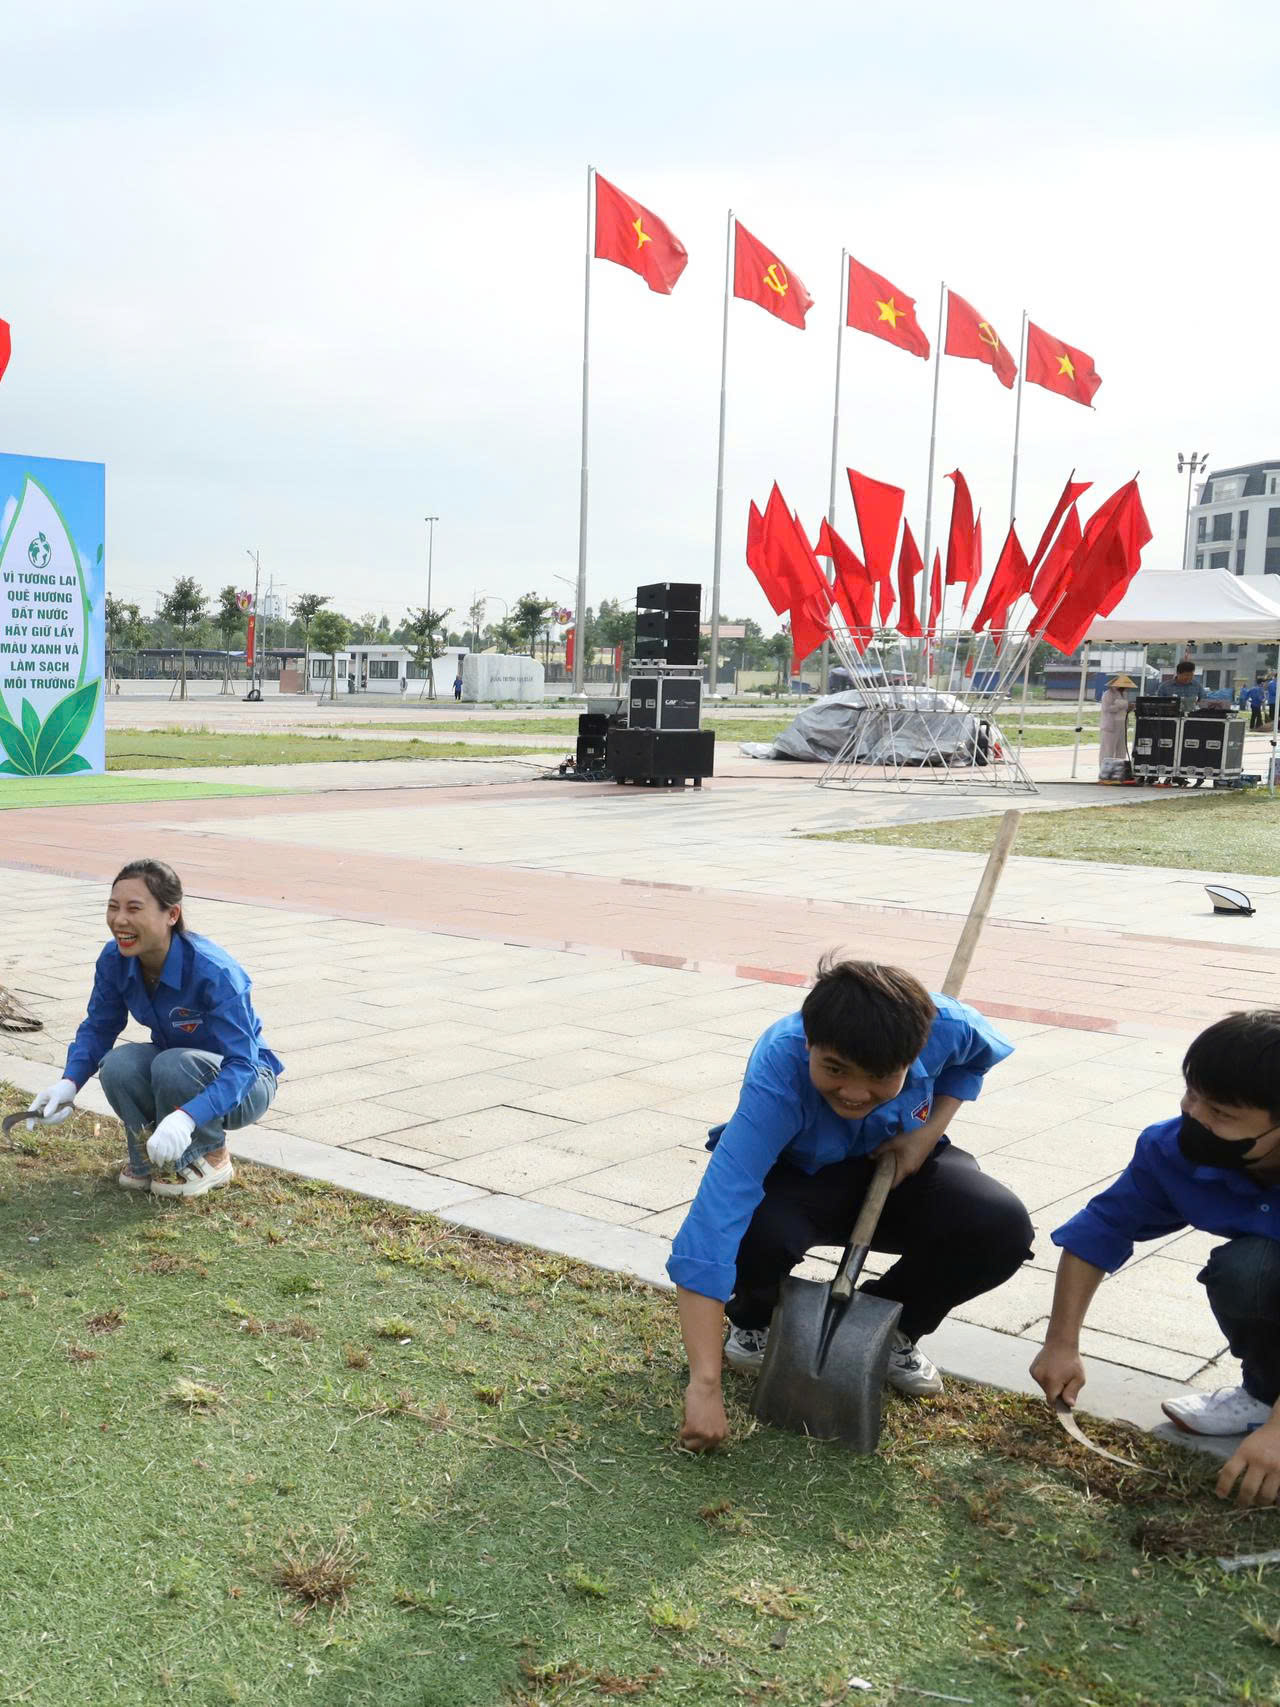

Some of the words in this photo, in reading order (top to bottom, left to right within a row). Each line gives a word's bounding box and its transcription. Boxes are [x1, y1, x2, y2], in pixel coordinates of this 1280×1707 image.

[18, 573, 56, 585] TƯƠNG
[59, 575, 76, 586] LAI
[7, 589, 30, 602] QUÊ
[34, 591, 72, 603] HƯƠNG
[11, 605, 34, 619] ĐẤT
[37, 607, 68, 620] NƯỚC
[5, 624, 27, 636] HÃY
[31, 625, 52, 637] GIỮ
[54, 623, 74, 638] LẤY
[0, 641, 27, 653] MÀU
[30, 643, 62, 654] XANH
[65, 642, 79, 655] VÀ
[10, 658, 36, 671] LÀM
[39, 661, 69, 674] SẠCH
[4, 676, 27, 689] MÔI
[30, 676, 76, 689] TRƯỜNG
